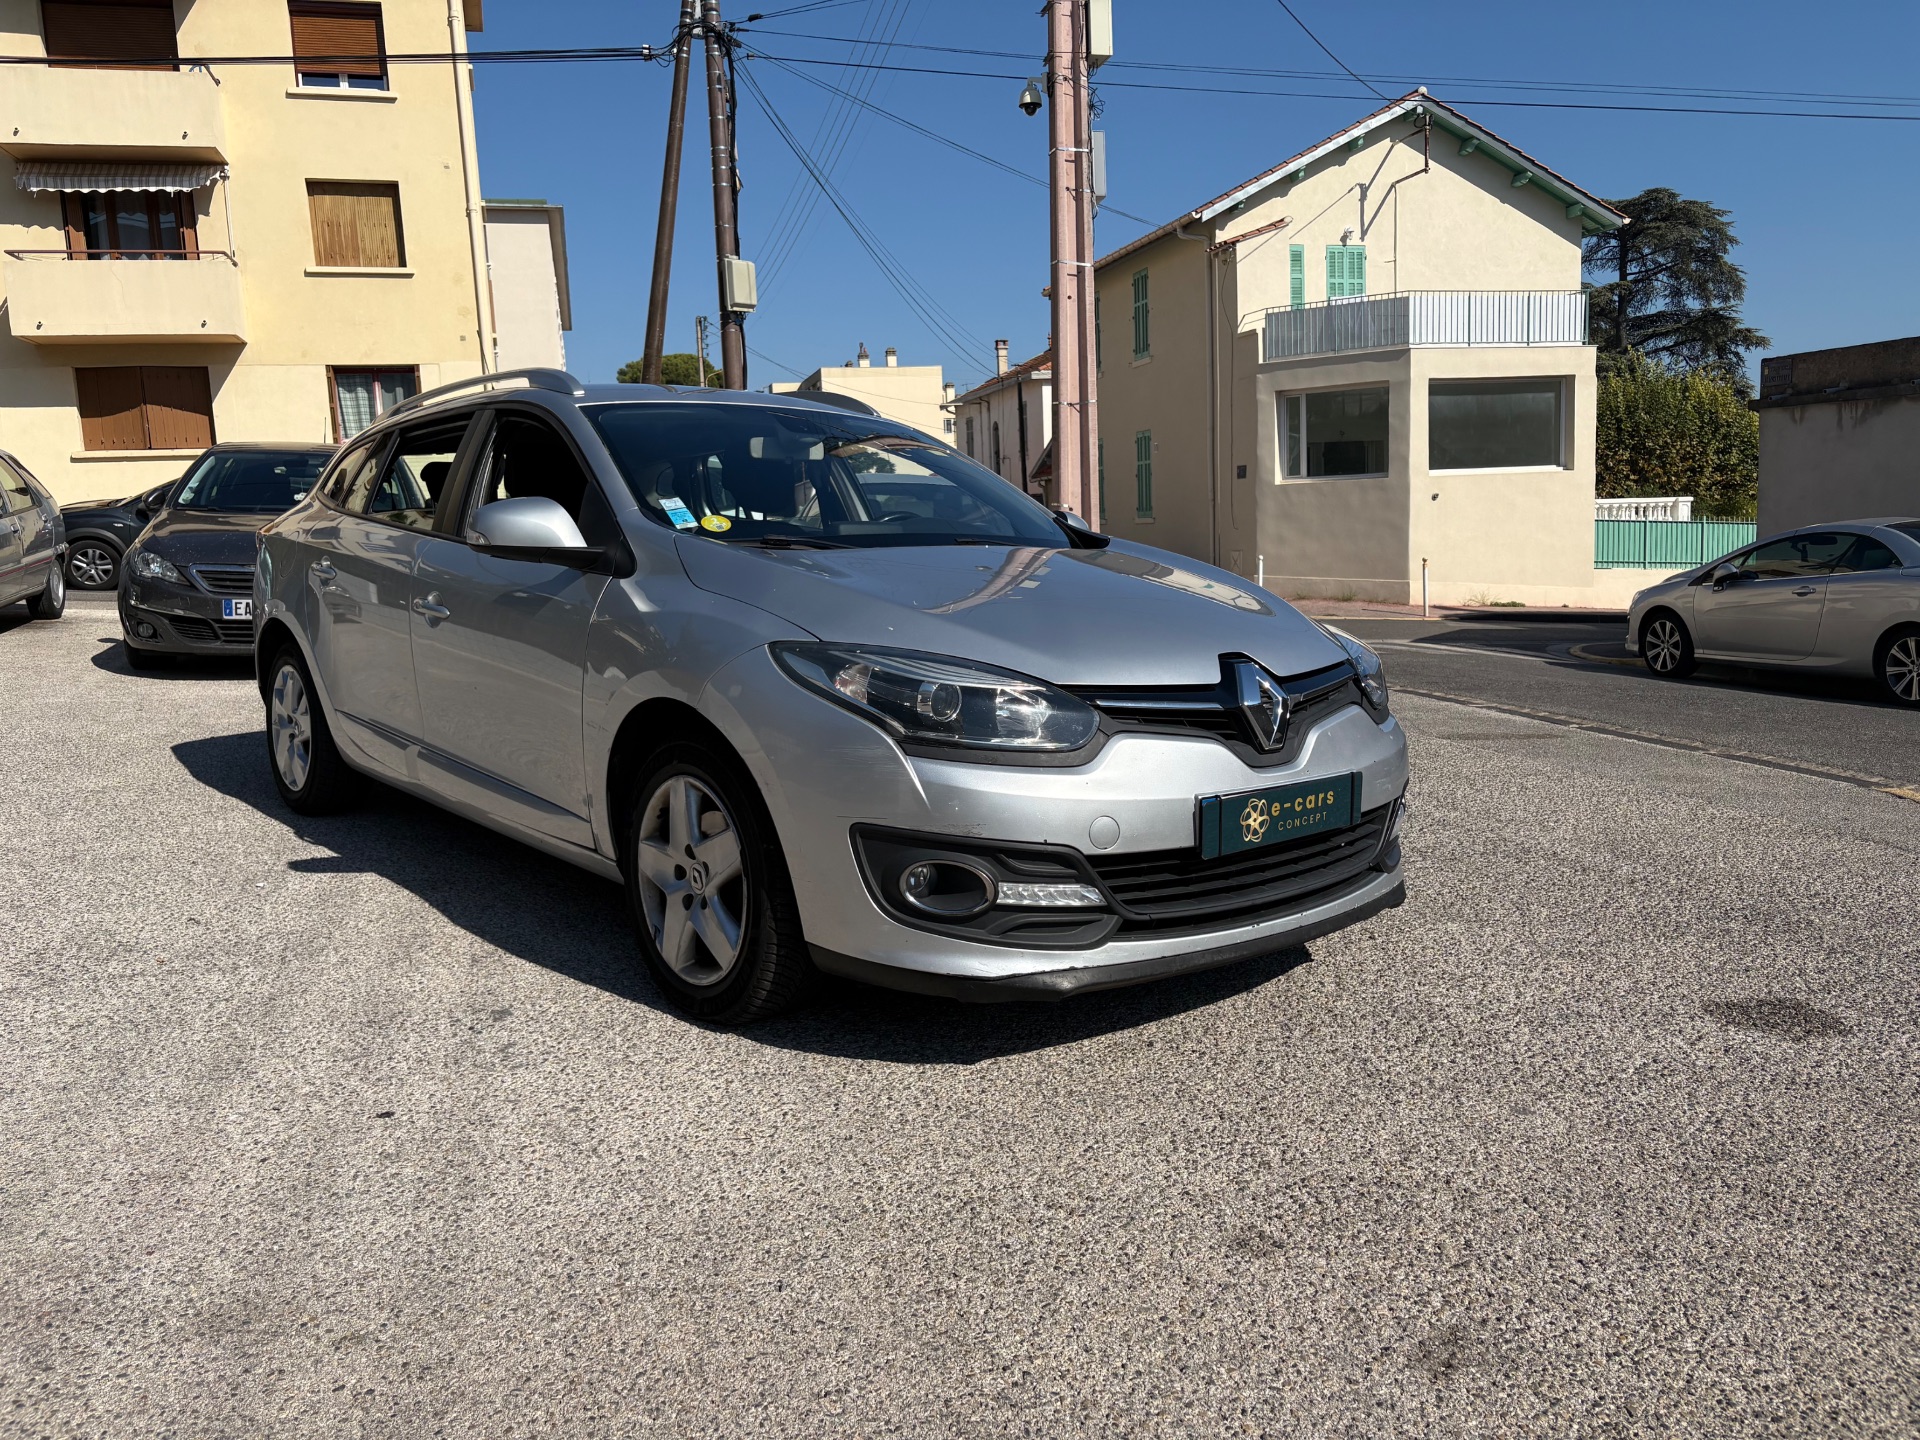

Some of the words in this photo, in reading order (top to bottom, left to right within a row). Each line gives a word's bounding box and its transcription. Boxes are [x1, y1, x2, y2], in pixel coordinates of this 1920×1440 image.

[235, 601, 252, 616] EA
[1271, 790, 1334, 816] e-cars
[1278, 812, 1327, 831] CONCEPT
